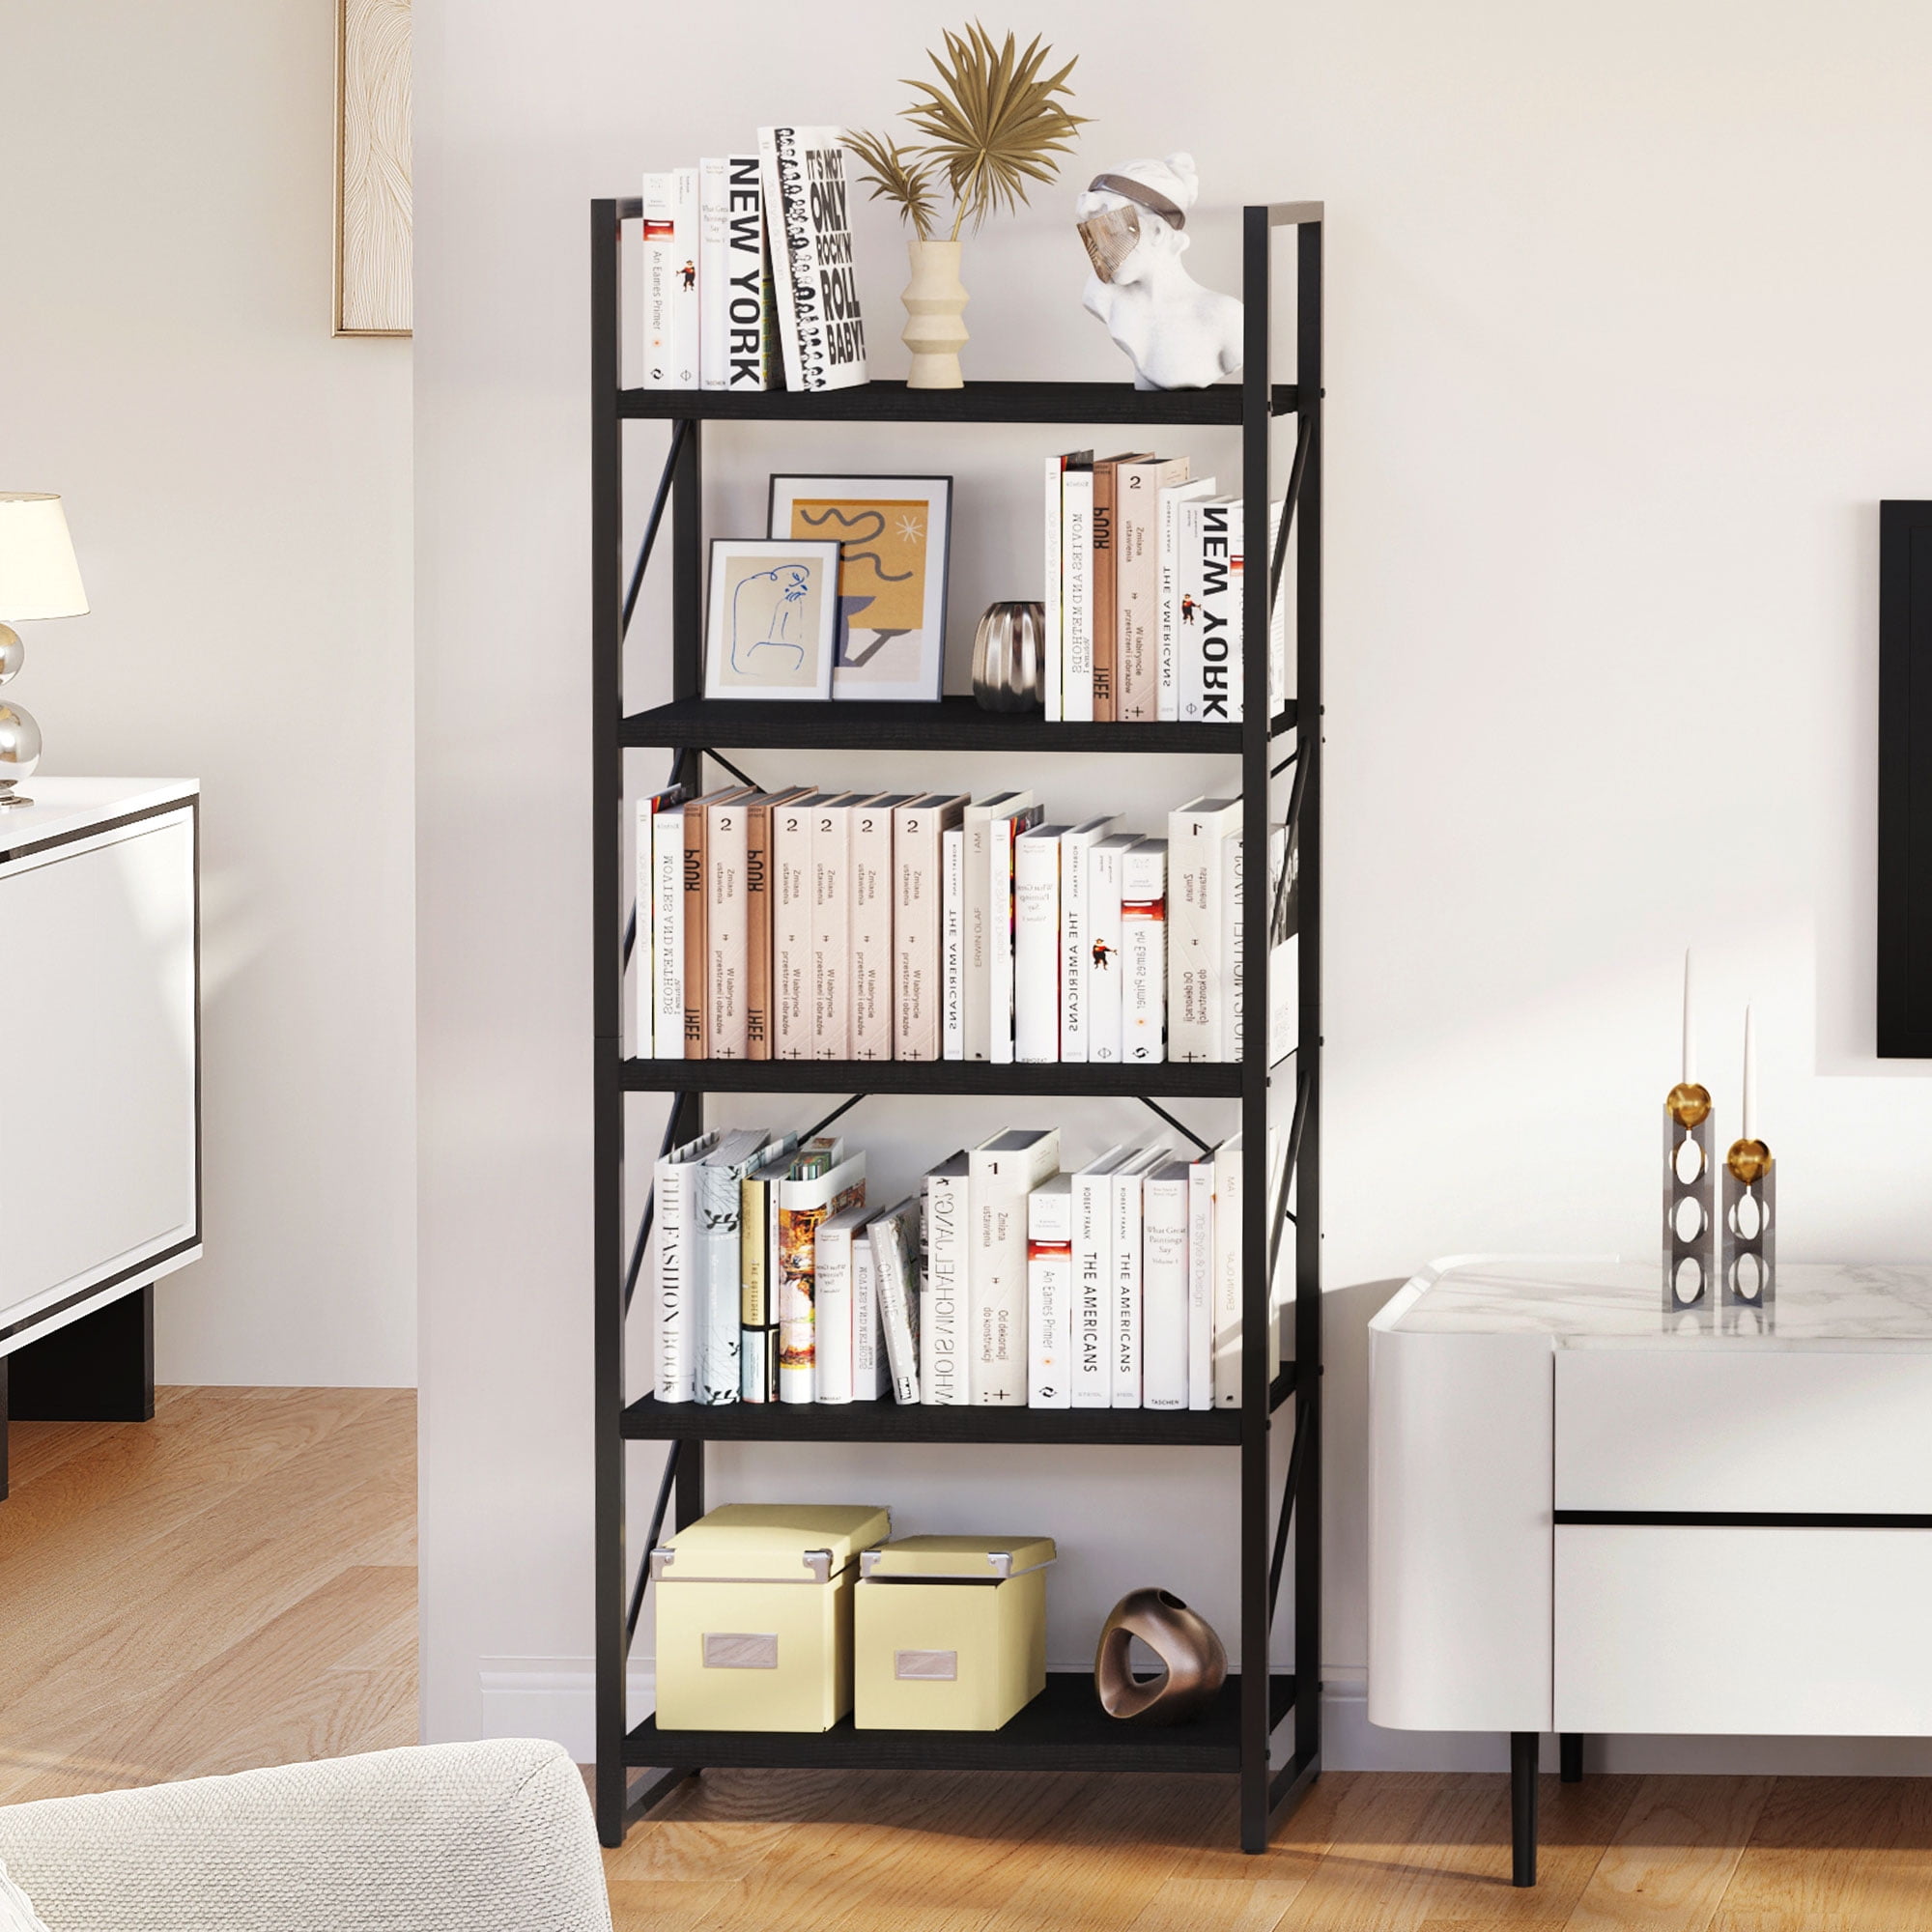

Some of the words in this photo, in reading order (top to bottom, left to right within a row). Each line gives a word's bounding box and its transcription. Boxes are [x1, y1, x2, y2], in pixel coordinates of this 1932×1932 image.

[806, 150, 823, 181] IT'S
[825, 149, 843, 181] NOT
[729, 158, 760, 254] NEW
[810, 181, 848, 233] ONLY
[653, 251, 662, 264] An
[816, 233, 852, 266] ROCK'N
[653, 267, 662, 297] Eames
[820, 269, 861, 321] ROLL
[653, 300, 662, 329] Primer
[729, 269, 760, 385] YORK
[826, 321, 867, 365] BABY!
[1130, 476, 1141, 489] 2
[1124, 610, 1133, 653] przestrzeni
[1136, 626, 1144, 637] W
[1134, 637, 1144, 675] labiryncie
[721, 818, 732, 832] 2
[786, 819, 798, 832] 2
[821, 819, 833, 833] 2
[862, 820, 873, 833] 2
[907, 820, 919, 833] 2
[975, 832, 982, 848] AM
[716, 951, 724, 994] przestrzeni
[726, 968, 734, 978] W
[781, 951, 790, 995] przestrzeni
[793, 969, 801, 978] W
[828, 969, 835, 979] W
[857, 952, 866, 996] przestrzeni
[868, 970, 875, 979] W
[902, 952, 911, 996] przestrzeni
[914, 970, 922, 979] W
[724, 978, 734, 1017] labiryncie
[791, 979, 801, 1017] labiryncie
[826, 979, 835, 1018] labiryncie
[867, 980, 875, 1018] labiryncie
[912, 980, 922, 1019] labiryncie
[988, 1162, 998, 1175] 1
[663, 1173, 680, 1219] THE
[983, 1206, 992, 1248] ustawienia
[998, 1212, 1009, 1241] Zmiana
[1147, 1226, 1165, 1235] What
[663, 1226, 680, 1323] FASHION
[877, 1263, 892, 1284] ON
[1043, 1270, 1055, 1283] An
[1083, 1252, 1097, 1280] THE
[1121, 1253, 1130, 1280] THE
[881, 1289, 897, 1319] LINE
[983, 1307, 993, 1319] do
[998, 1310, 1009, 1322] Od
[1043, 1286, 1055, 1316] Eames
[982, 1320, 993, 1363] konstrukcji
[997, 1323, 1009, 1360] dekoracji
[1043, 1319, 1055, 1350] Primer
[1083, 1286, 1097, 1373] AMERICANS
[1121, 1286, 1130, 1373] AMERICANS
[663, 1330, 680, 1394] BOOK
